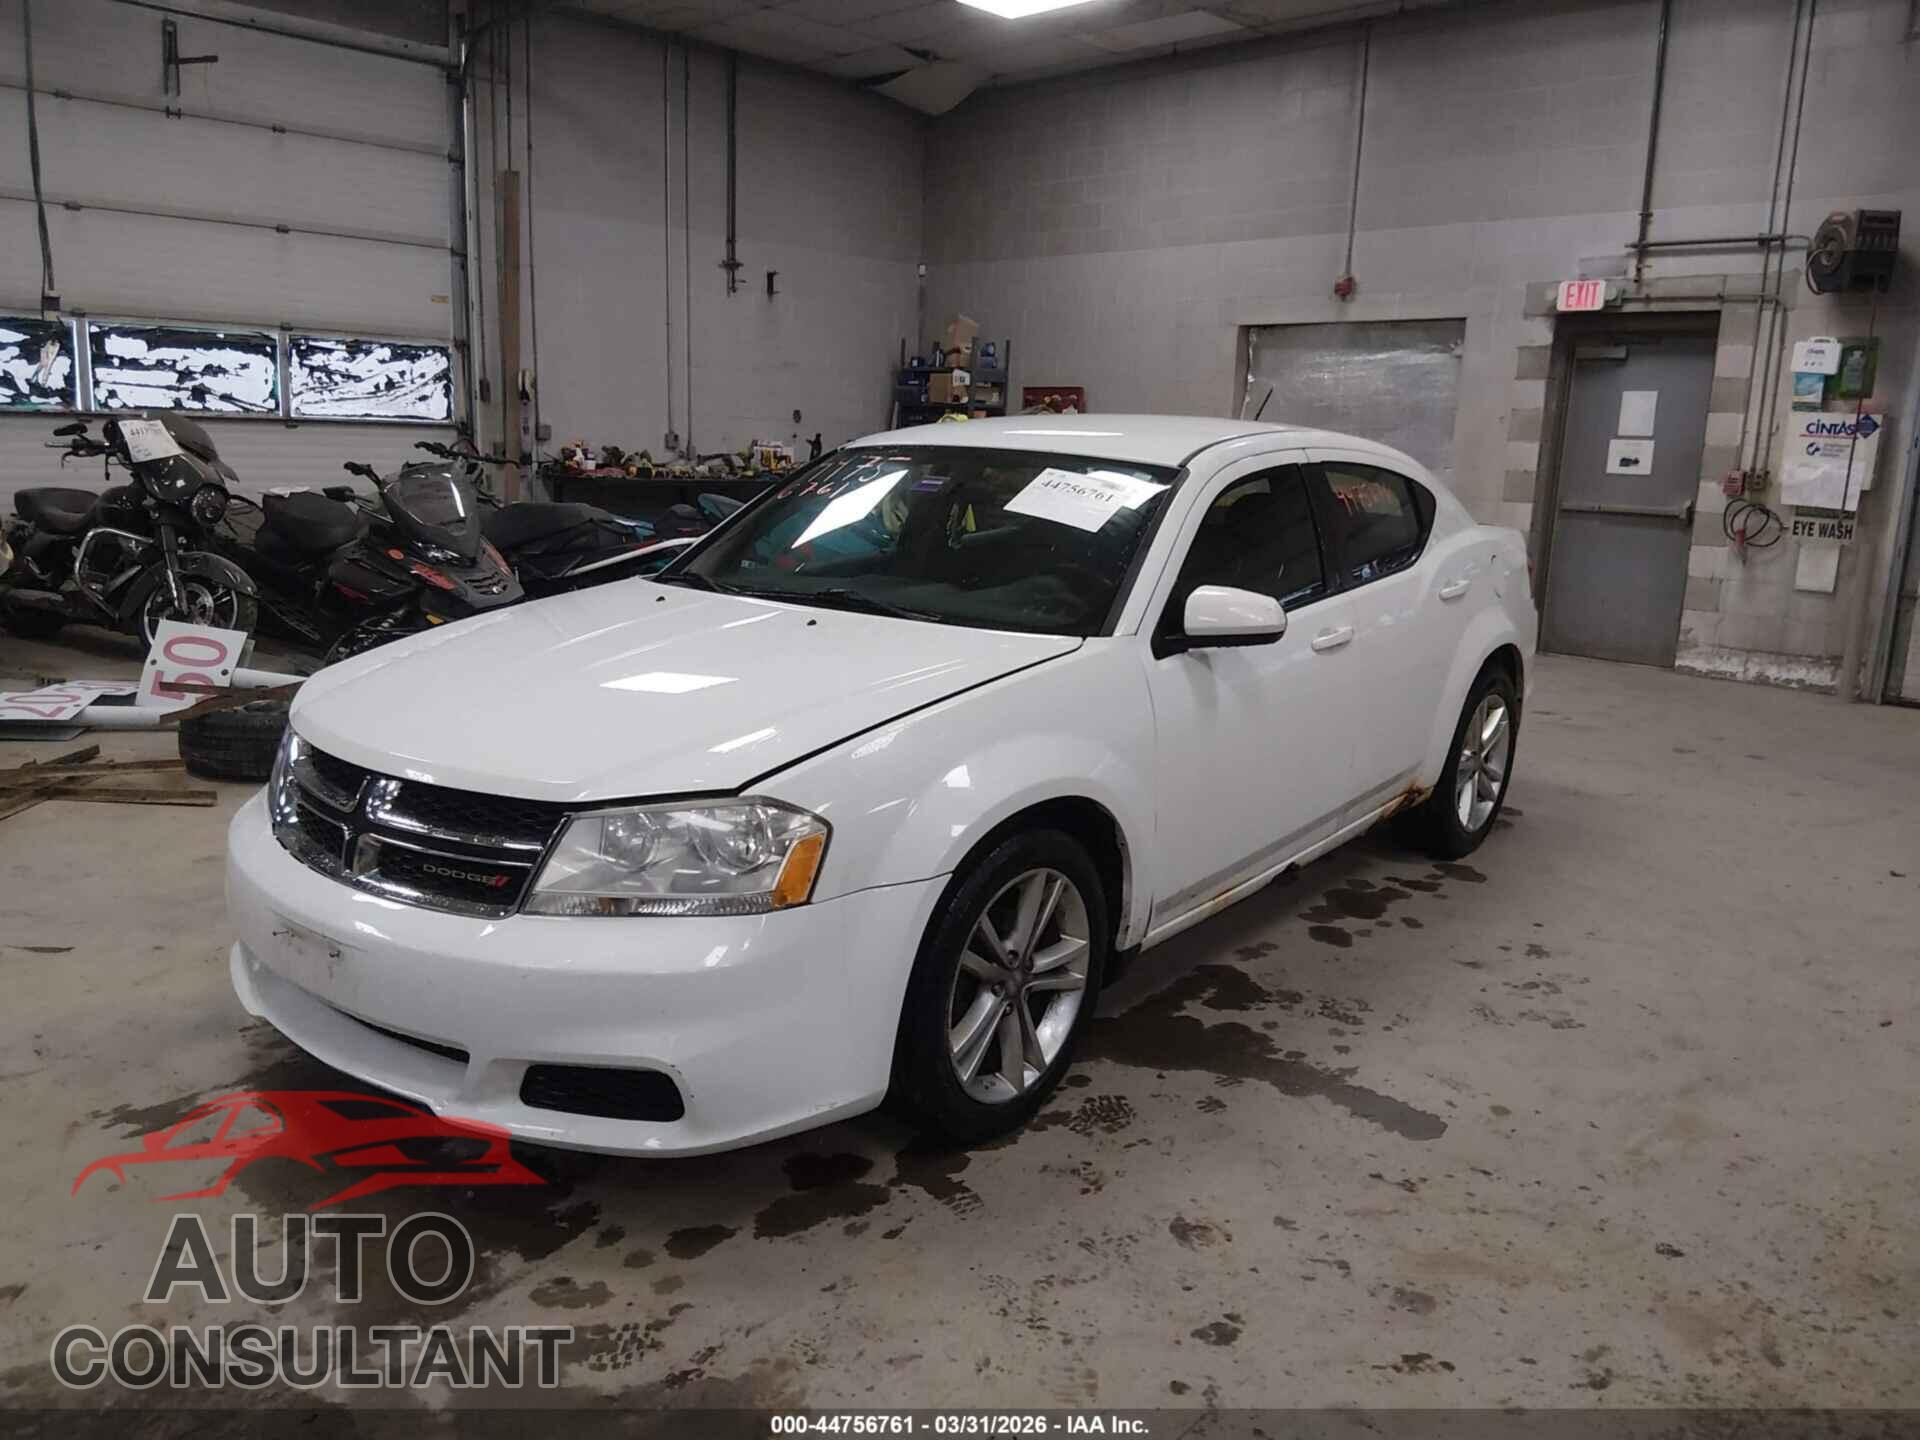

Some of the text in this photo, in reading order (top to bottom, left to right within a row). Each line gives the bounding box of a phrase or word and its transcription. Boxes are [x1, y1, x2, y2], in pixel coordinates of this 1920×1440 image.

[1566, 283, 1600, 307] EXIT
[1041, 479, 1114, 502] 44756761
[1792, 521, 1853, 540] EYE WASH
[150, 636, 228, 701] 50
[423, 864, 496, 883] DODGE
